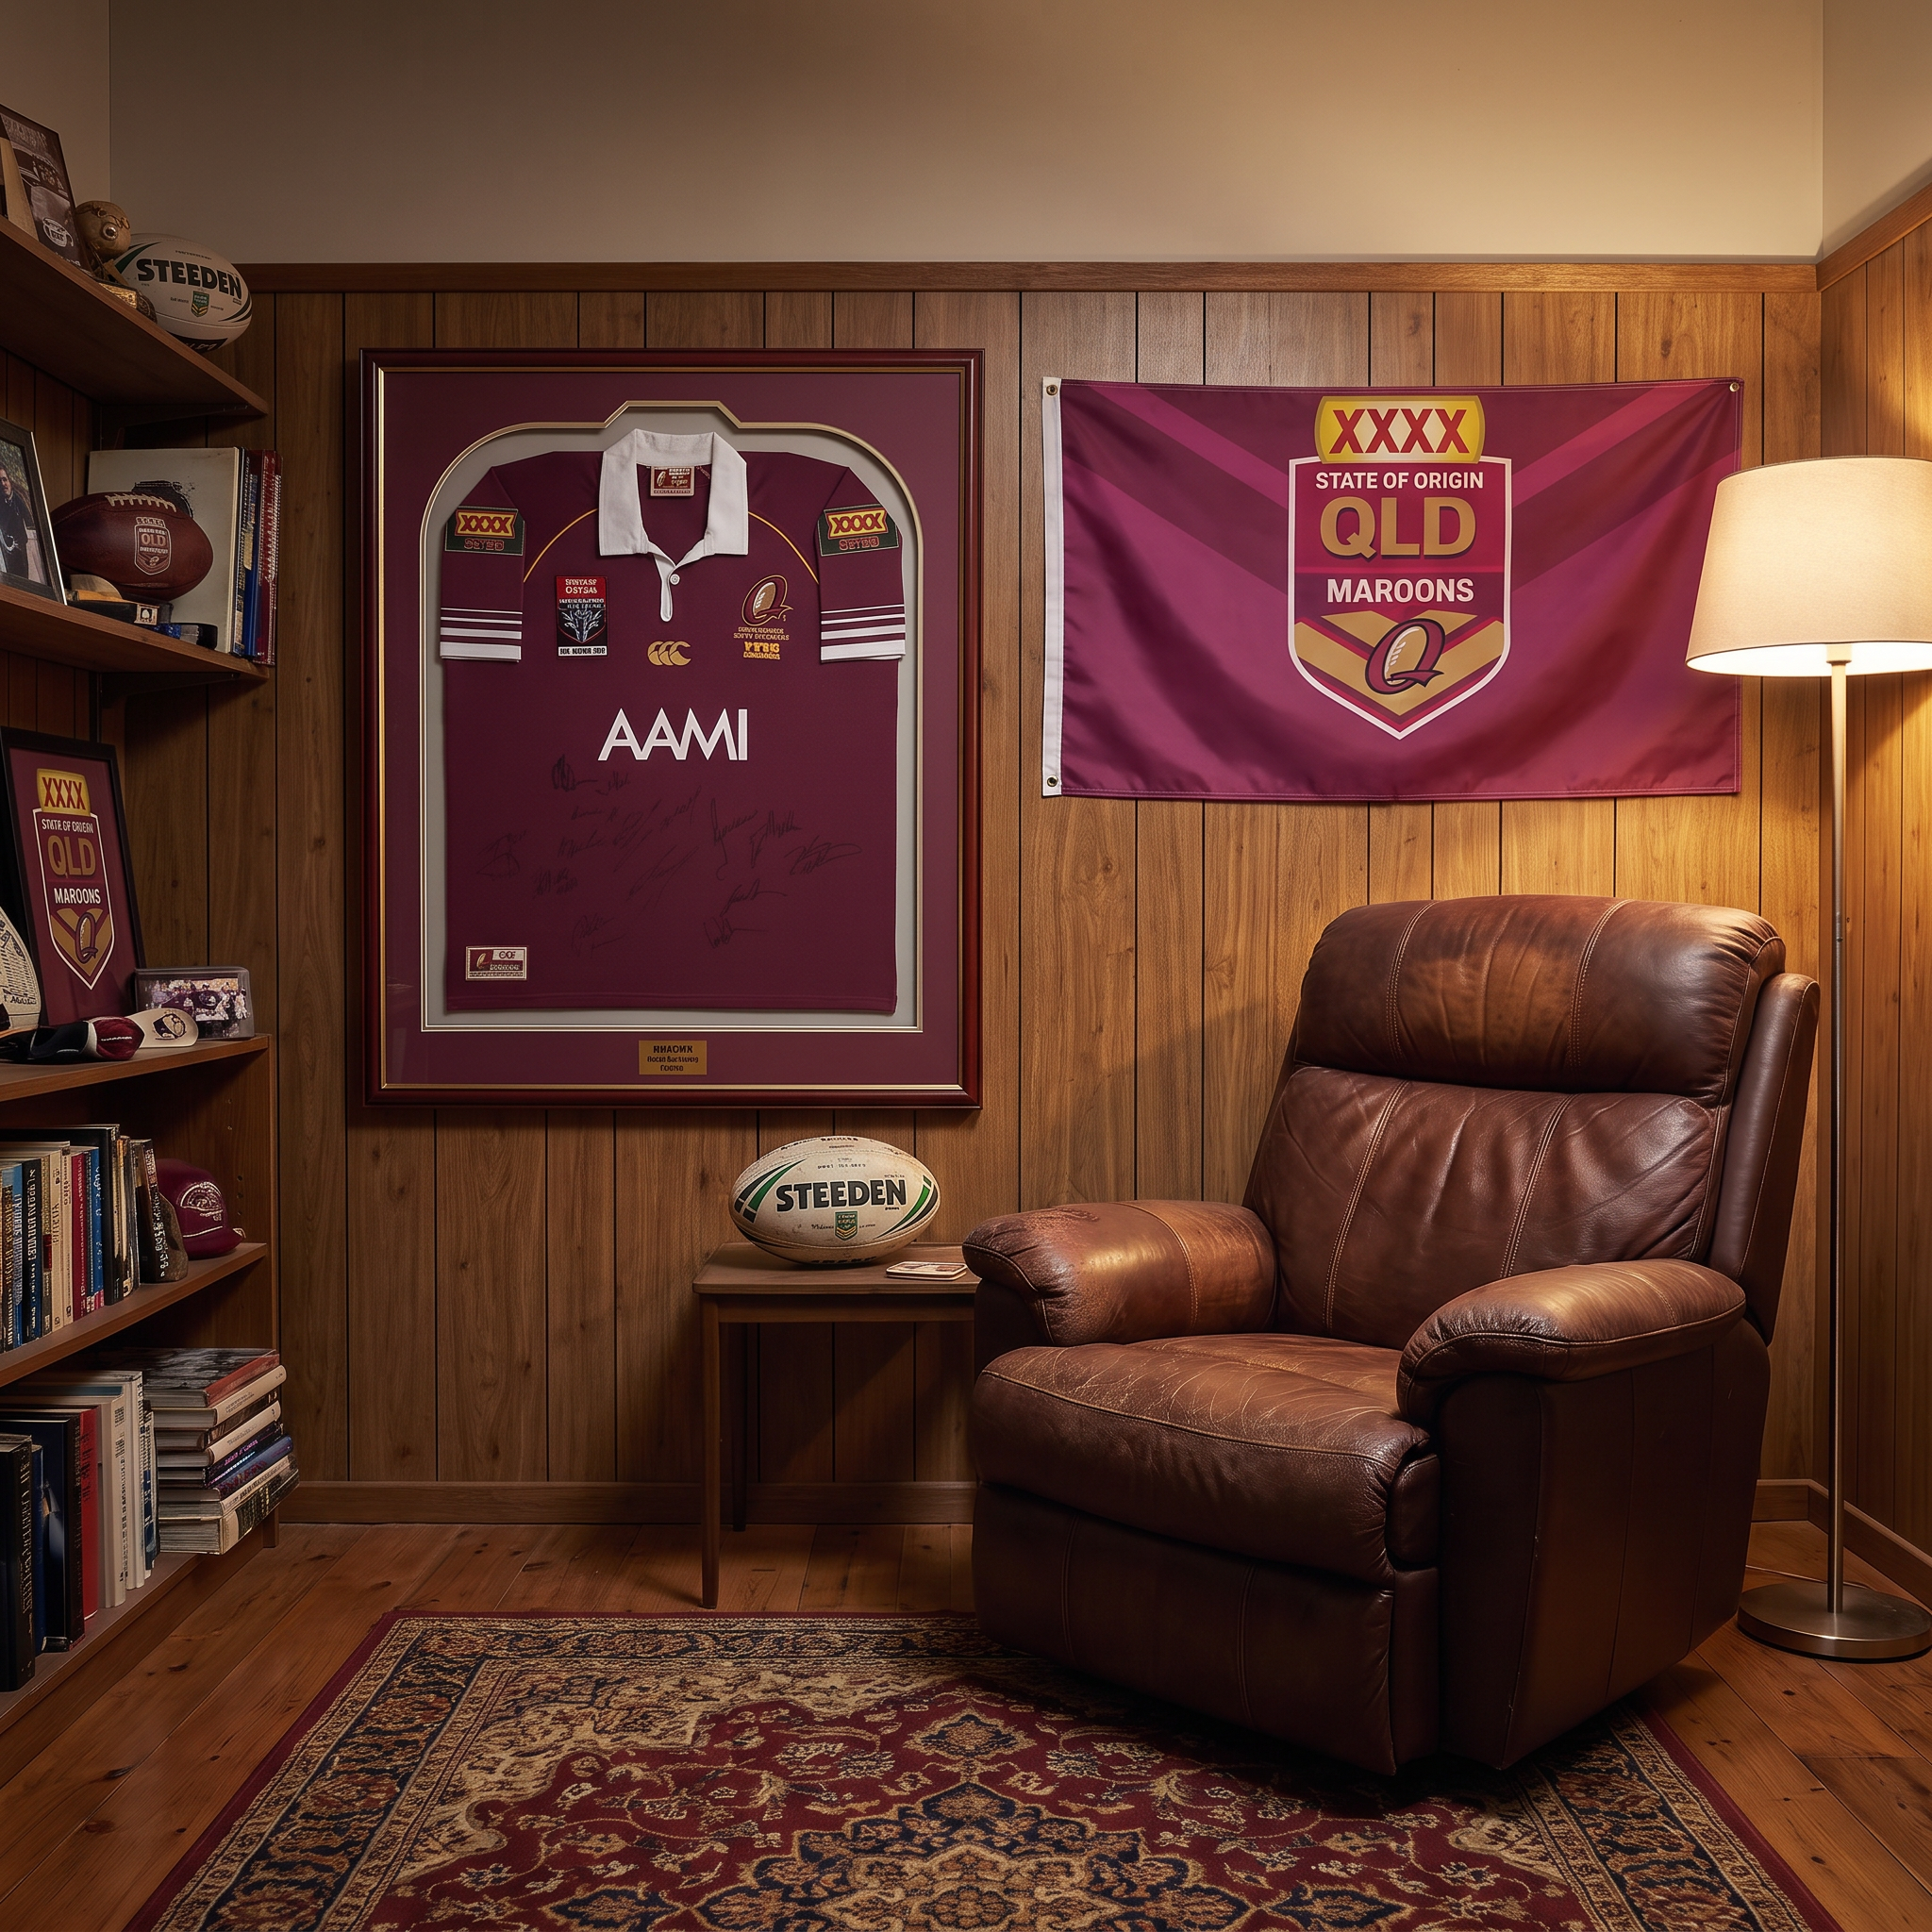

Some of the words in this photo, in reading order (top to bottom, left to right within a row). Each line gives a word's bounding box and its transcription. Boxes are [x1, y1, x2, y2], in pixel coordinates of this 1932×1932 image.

[136, 258, 242, 300] STEEDEN
[1328, 408, 1471, 455] XXXX
[1315, 472, 1378, 490] STATE
[1382, 472, 1409, 490] OF
[1413, 471, 1484, 490] ORIGIN
[1320, 495, 1476, 559] QLD
[1326, 577, 1474, 603] MAROONS
[598, 708, 748, 761] AAMI
[42, 776, 86, 810] XXXX
[47, 835, 96, 876] QLD
[54, 888, 101, 905] MAROONS
[775, 1179, 908, 1213] STEEDEN
